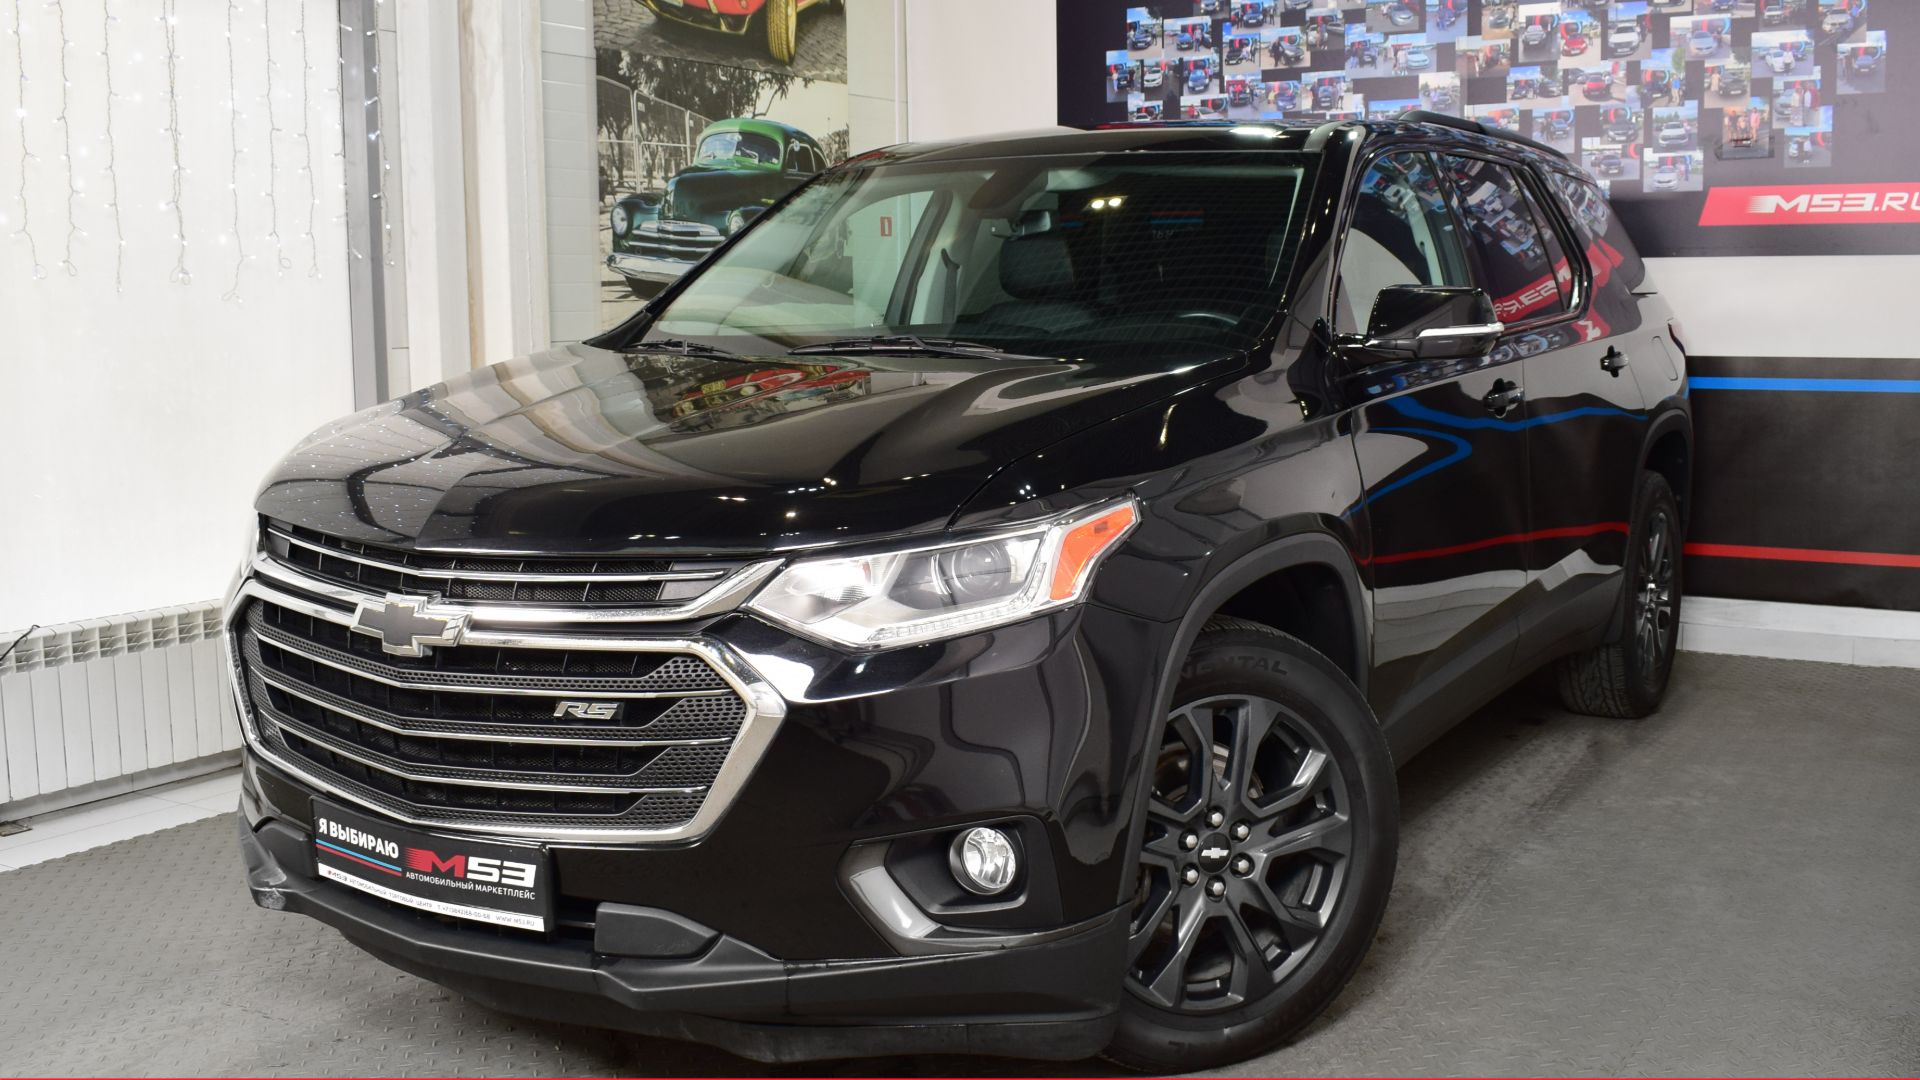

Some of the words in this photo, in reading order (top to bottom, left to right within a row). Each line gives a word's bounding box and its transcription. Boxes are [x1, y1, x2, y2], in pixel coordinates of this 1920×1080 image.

[553, 701, 618, 720] RS
[319, 818, 327, 834] Я
[329, 821, 399, 859] ВЫБИРАЮ
[405, 847, 537, 888] M53
[405, 871, 474, 891] АВТОМОБИЛЬНЫЙ
[475, 884, 536, 900] МАРКЕТПЛЕЙС
